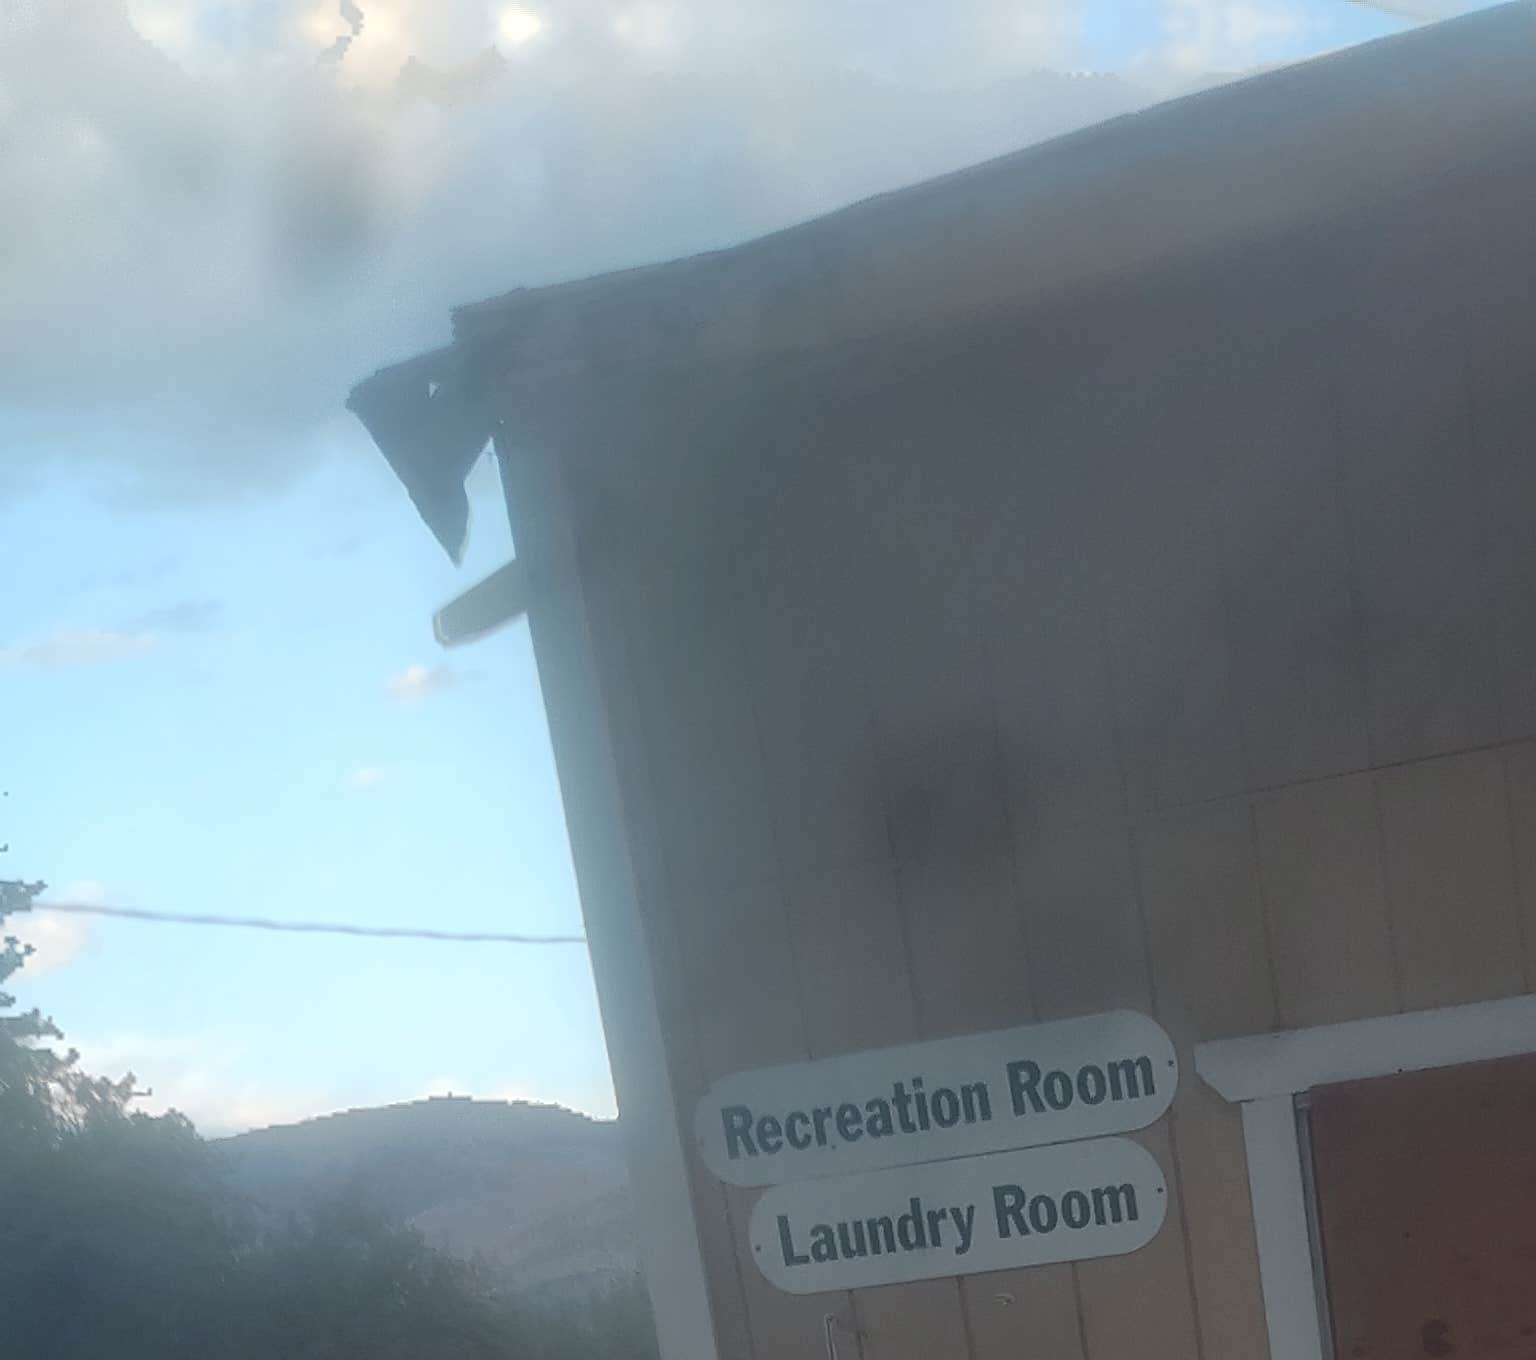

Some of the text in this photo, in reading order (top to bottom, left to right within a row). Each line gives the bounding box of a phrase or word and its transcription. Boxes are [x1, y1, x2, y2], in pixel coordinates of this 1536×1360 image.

[720, 1055, 1156, 1159] Recreation Room
[777, 1181, 1139, 1267] Laundry Room
